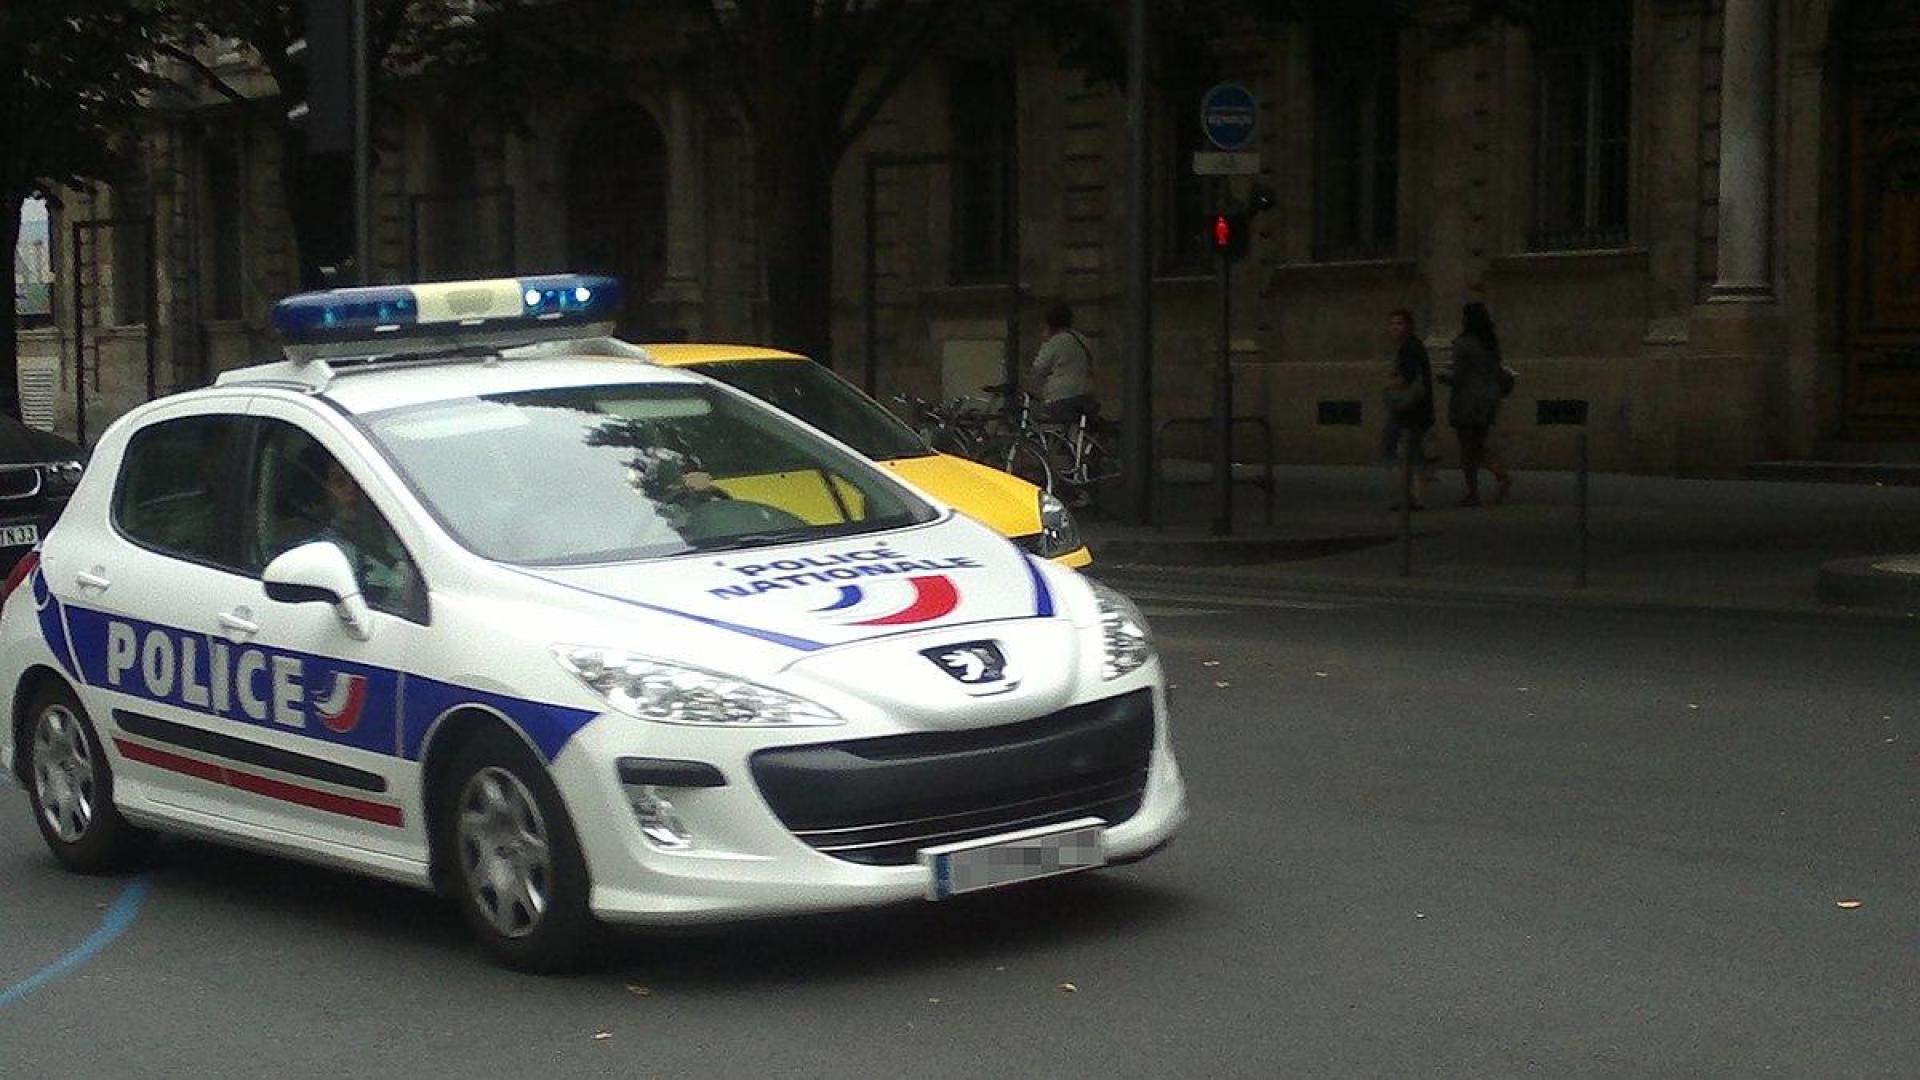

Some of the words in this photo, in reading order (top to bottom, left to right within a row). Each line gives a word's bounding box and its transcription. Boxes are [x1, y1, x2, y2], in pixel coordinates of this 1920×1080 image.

[707, 556, 984, 600] NATIONALE
[732, 548, 907, 576] POLICE
[107, 621, 306, 728] POLICE
